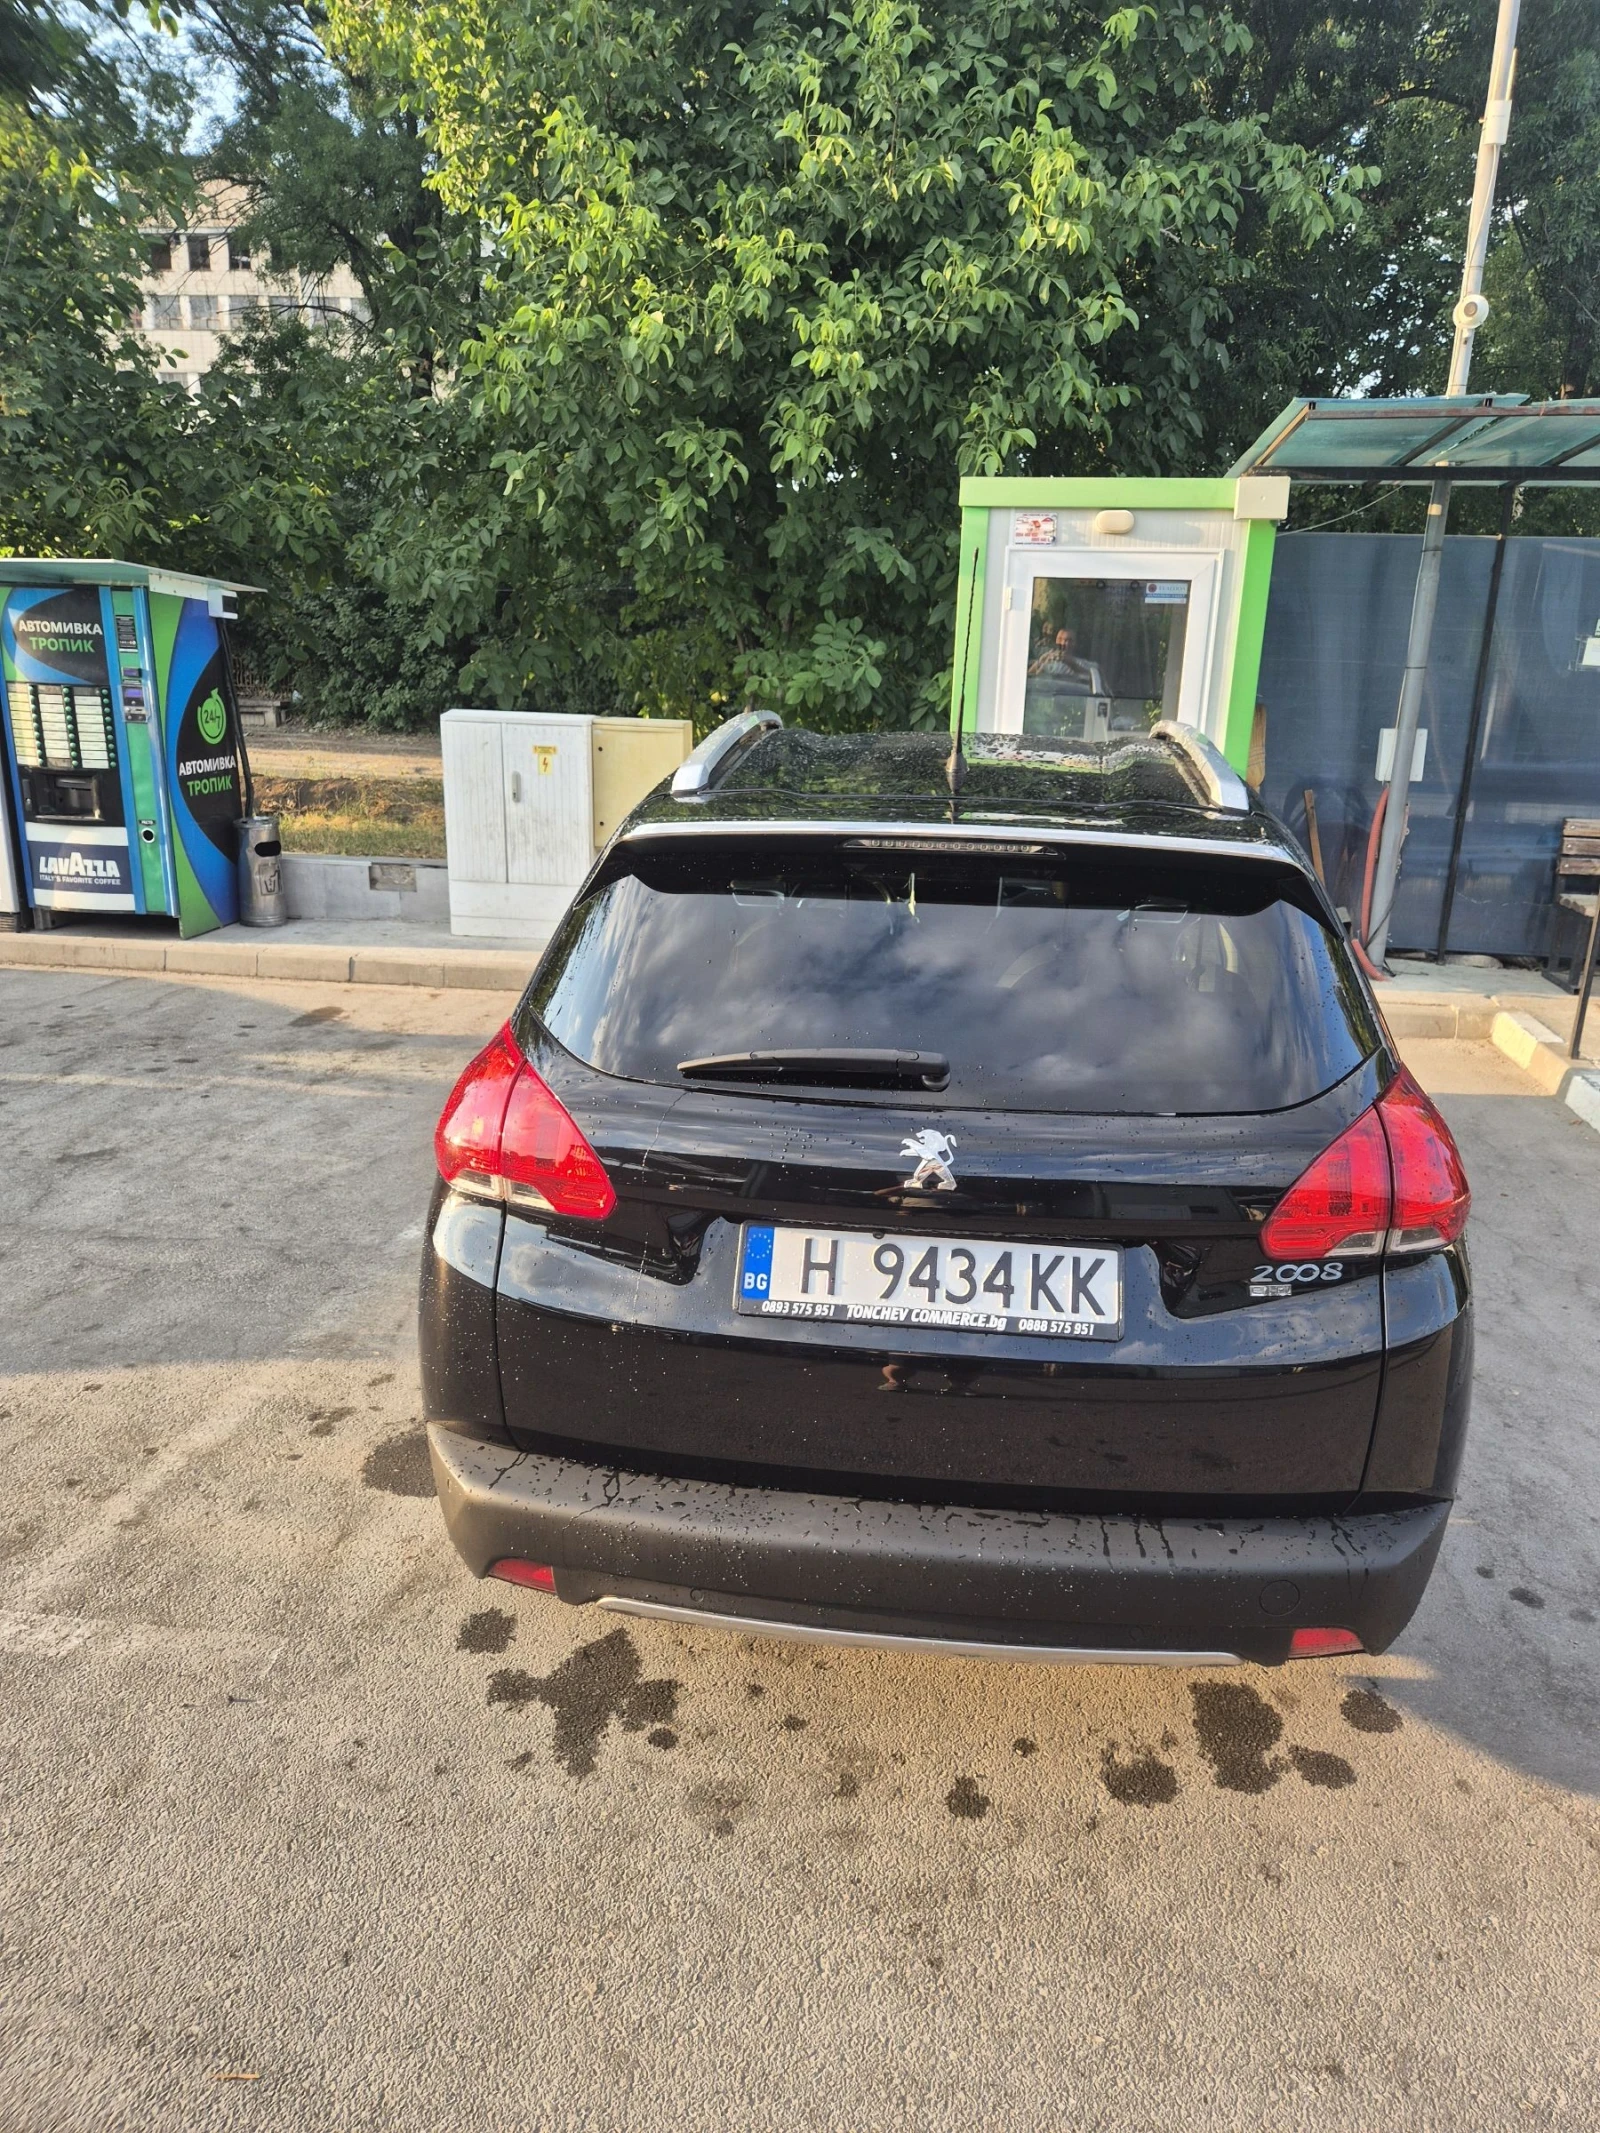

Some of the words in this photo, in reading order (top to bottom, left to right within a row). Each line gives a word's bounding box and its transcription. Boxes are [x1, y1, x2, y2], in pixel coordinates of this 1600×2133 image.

[19, 619, 103, 635] АВТОМИВКА
[28, 636, 95, 652] ТРОПИК
[179, 755, 236, 776] АВТОМИВКА
[187, 775, 232, 796] ТРОПИК
[39, 852, 120, 877] LAVAZZA
[39, 874, 61, 883] ITALY'S
[62, 876, 93, 884] FAVORITE
[801, 1238, 838, 1295] H
[1250, 1262, 1343, 1282] 2008
[743, 1272, 768, 1290] BG
[761, 1301, 789, 1314] 0893
[791, 1303, 812, 1315] 575
[815, 1304, 835, 1316] 951
[847, 1304, 910, 1321] TONCHEV
[911, 1308, 1007, 1331] COMMERCE.bg
[1018, 1319, 1049, 1332] 0888
[1050, 1321, 1071, 1334] 575
[1073, 1323, 1095, 1336] 951
